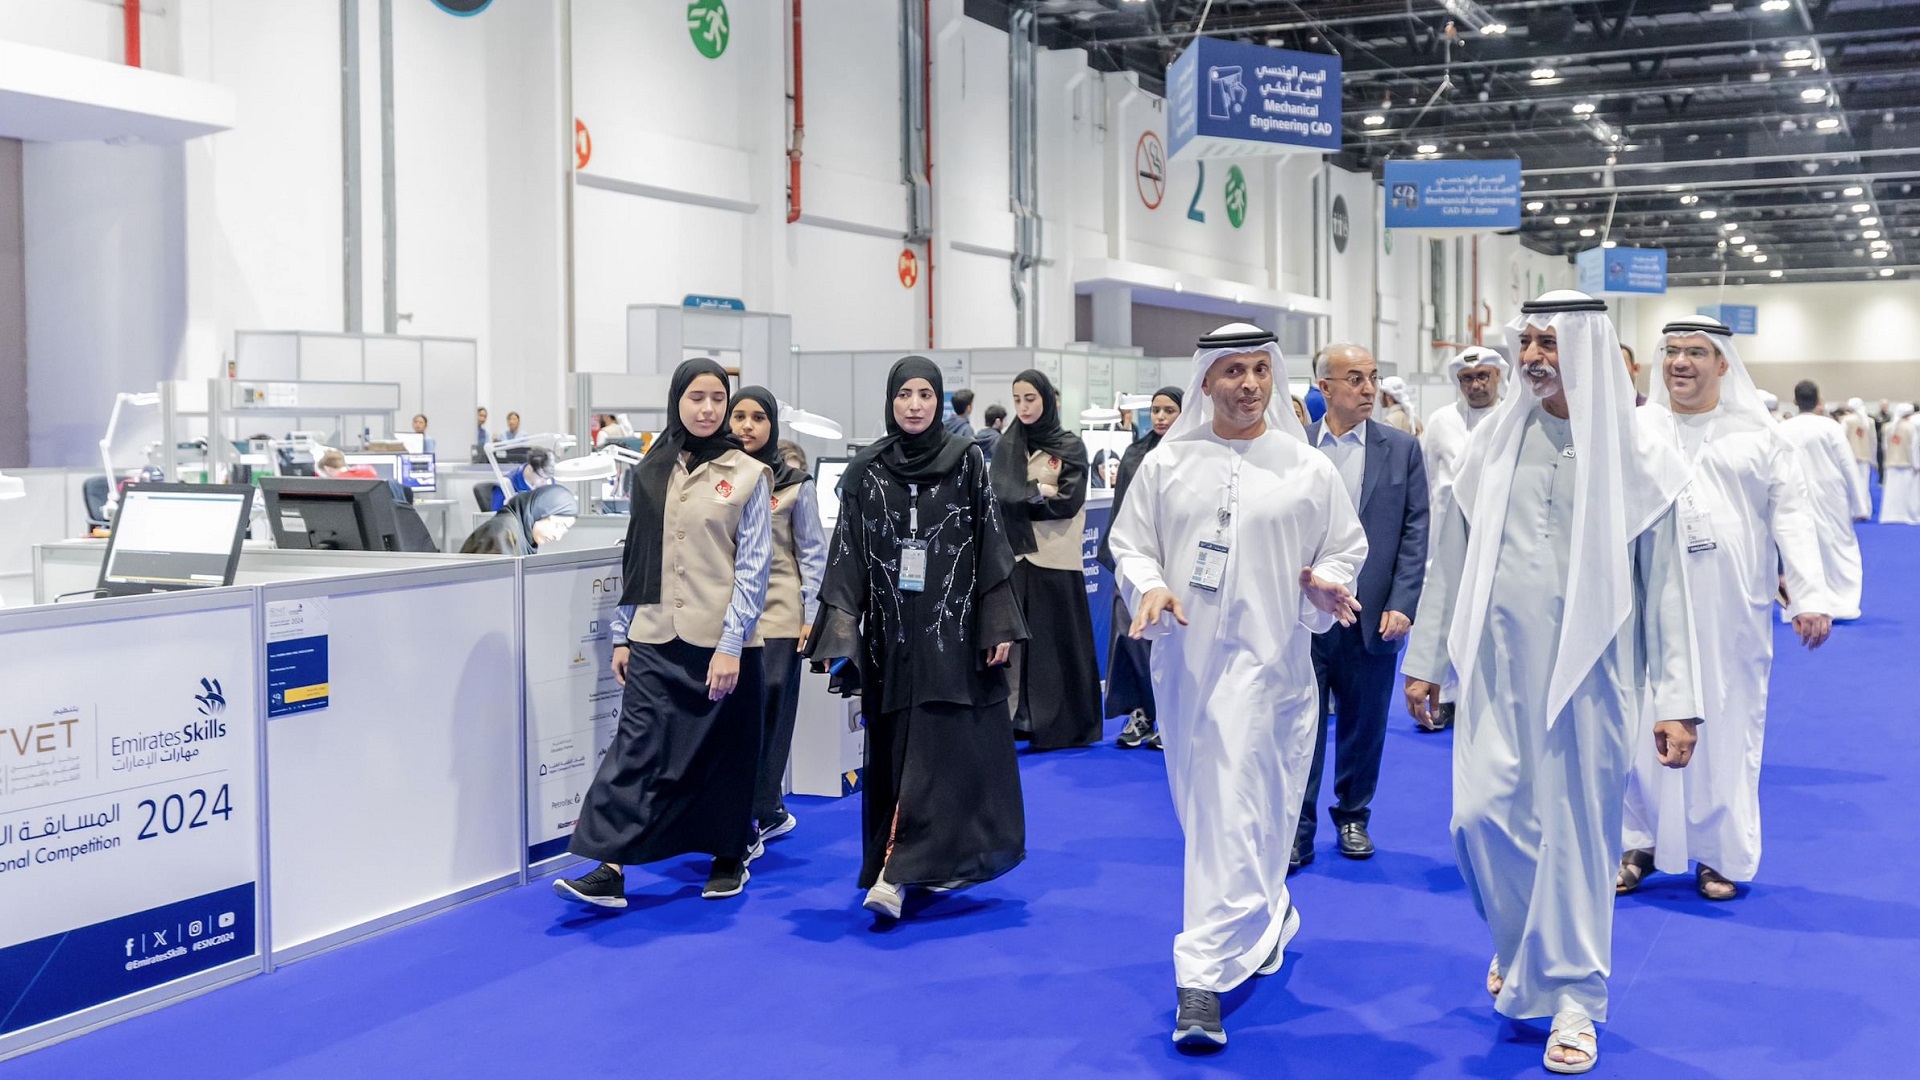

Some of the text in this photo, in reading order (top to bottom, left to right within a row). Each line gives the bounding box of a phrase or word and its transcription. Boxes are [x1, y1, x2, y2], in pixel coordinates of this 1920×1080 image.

[1255, 65, 1326, 83] الرسم الهندسي
[1259, 81, 1322, 98] الميكانيكي
[1264, 99, 1318, 117] Mechanical
[1250, 114, 1332, 135] Engineering CAD
[1443, 206, 1460, 215] CAD
[0, 718, 79, 756] VET
[160, 748, 200, 765] مهارات
[137, 783, 233, 841] 2024
[0, 849, 30, 873] onal
[35, 835, 121, 863] Competition
[125, 946, 188, 971] @EmiratesSkills
